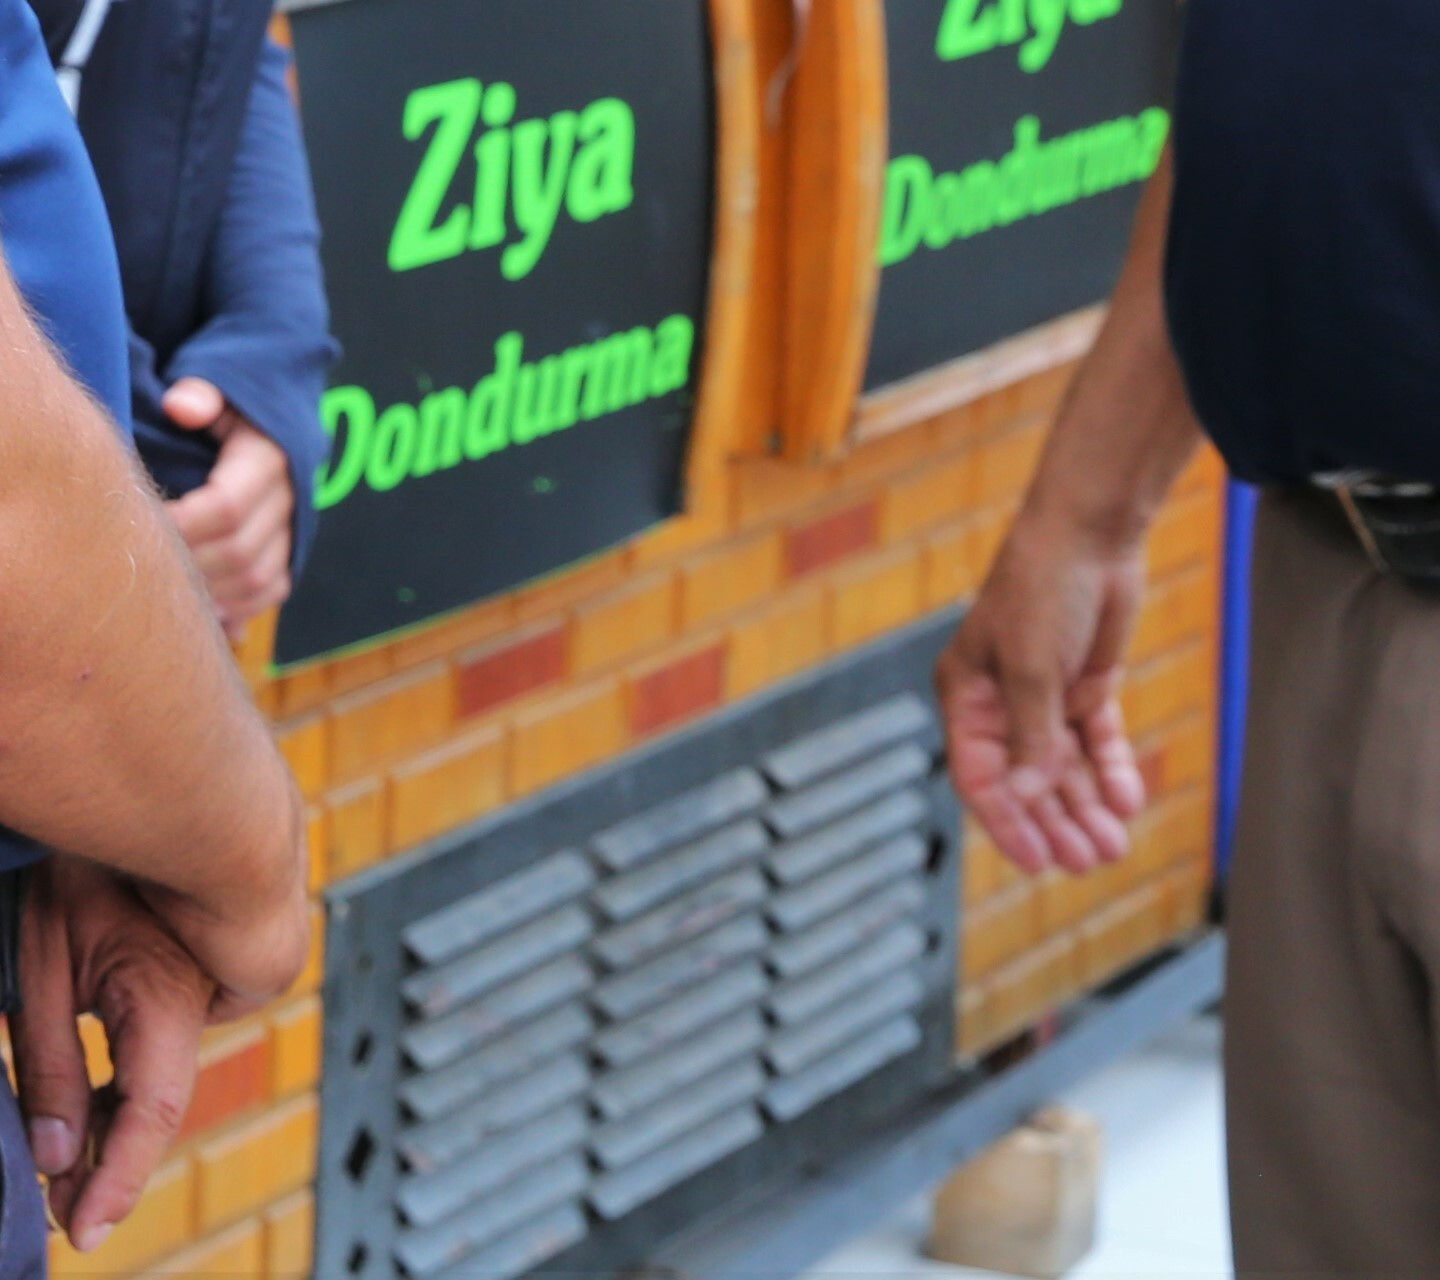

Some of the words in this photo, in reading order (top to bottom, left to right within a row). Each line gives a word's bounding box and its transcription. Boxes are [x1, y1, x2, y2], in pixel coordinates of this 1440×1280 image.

[387, 76, 635, 281] Ziya
[877, 105, 1171, 268] Dondurma
[312, 313, 695, 510] Dondurma
